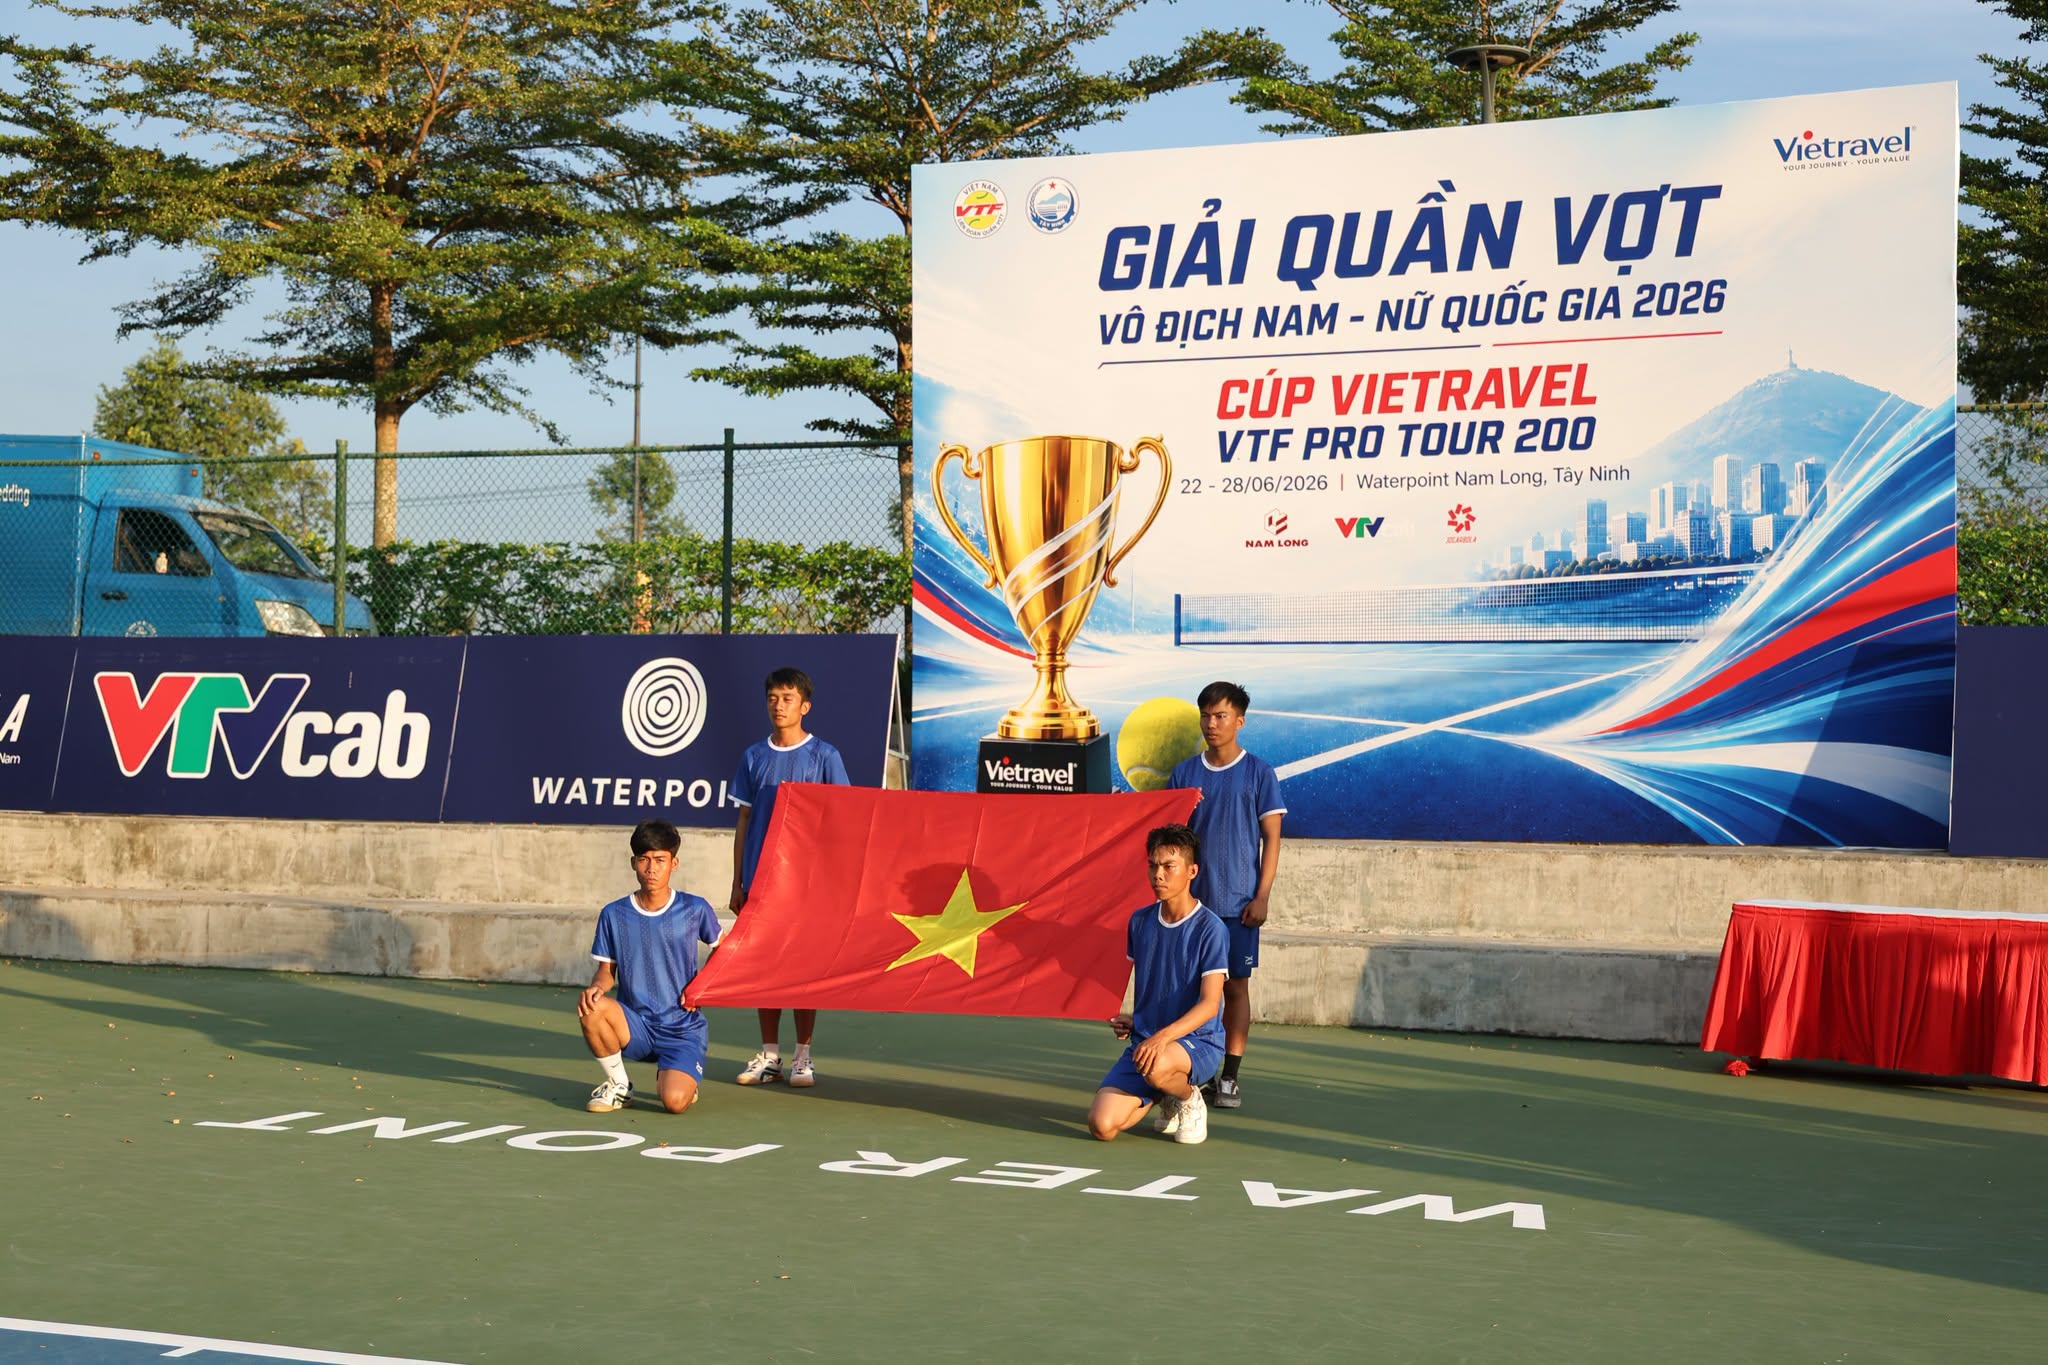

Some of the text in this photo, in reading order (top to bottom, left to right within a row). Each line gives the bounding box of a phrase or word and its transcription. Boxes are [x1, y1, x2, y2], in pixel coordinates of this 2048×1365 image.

[1773, 126, 1910, 162] Vietravel
[1808, 160, 1848, 169] JOURNEY
[1857, 157, 1880, 165] YOUR
[981, 182, 999, 194] NAM
[956, 203, 1004, 217] VTF
[1098, 179, 1723, 291] GIẢI QUẦN VỢT
[1099, 305, 1145, 345] VÔ
[1155, 308, 1243, 349] ĐỊCH
[1252, 302, 1339, 338] NAM
[1375, 291, 1434, 332] NỮ
[1441, 280, 1547, 333] QUỐC
[1558, 286, 1621, 322] GIA
[1632, 279, 1727, 318] 2026
[1216, 363, 1598, 420] CÚP VIETRAVEL
[1218, 416, 1597, 463] VTF PRO TOUR 200
[1180, 478, 1202, 494] 22
[1222, 474, 1328, 493] 28/06/2026
[1356, 471, 1449, 491] Waterpoint
[1455, 470, 1494, 487] Nam
[1500, 469, 1547, 487] Long,
[1553, 466, 1583, 486] Tây
[1589, 464, 1630, 482] Ninh
[1245, 538, 1309, 548] NAM LONG
[984, 755, 1074, 785] Vietravel
[532, 776, 741, 808] WATERPOI
[192, 1111, 1547, 1230] WATER POINT
